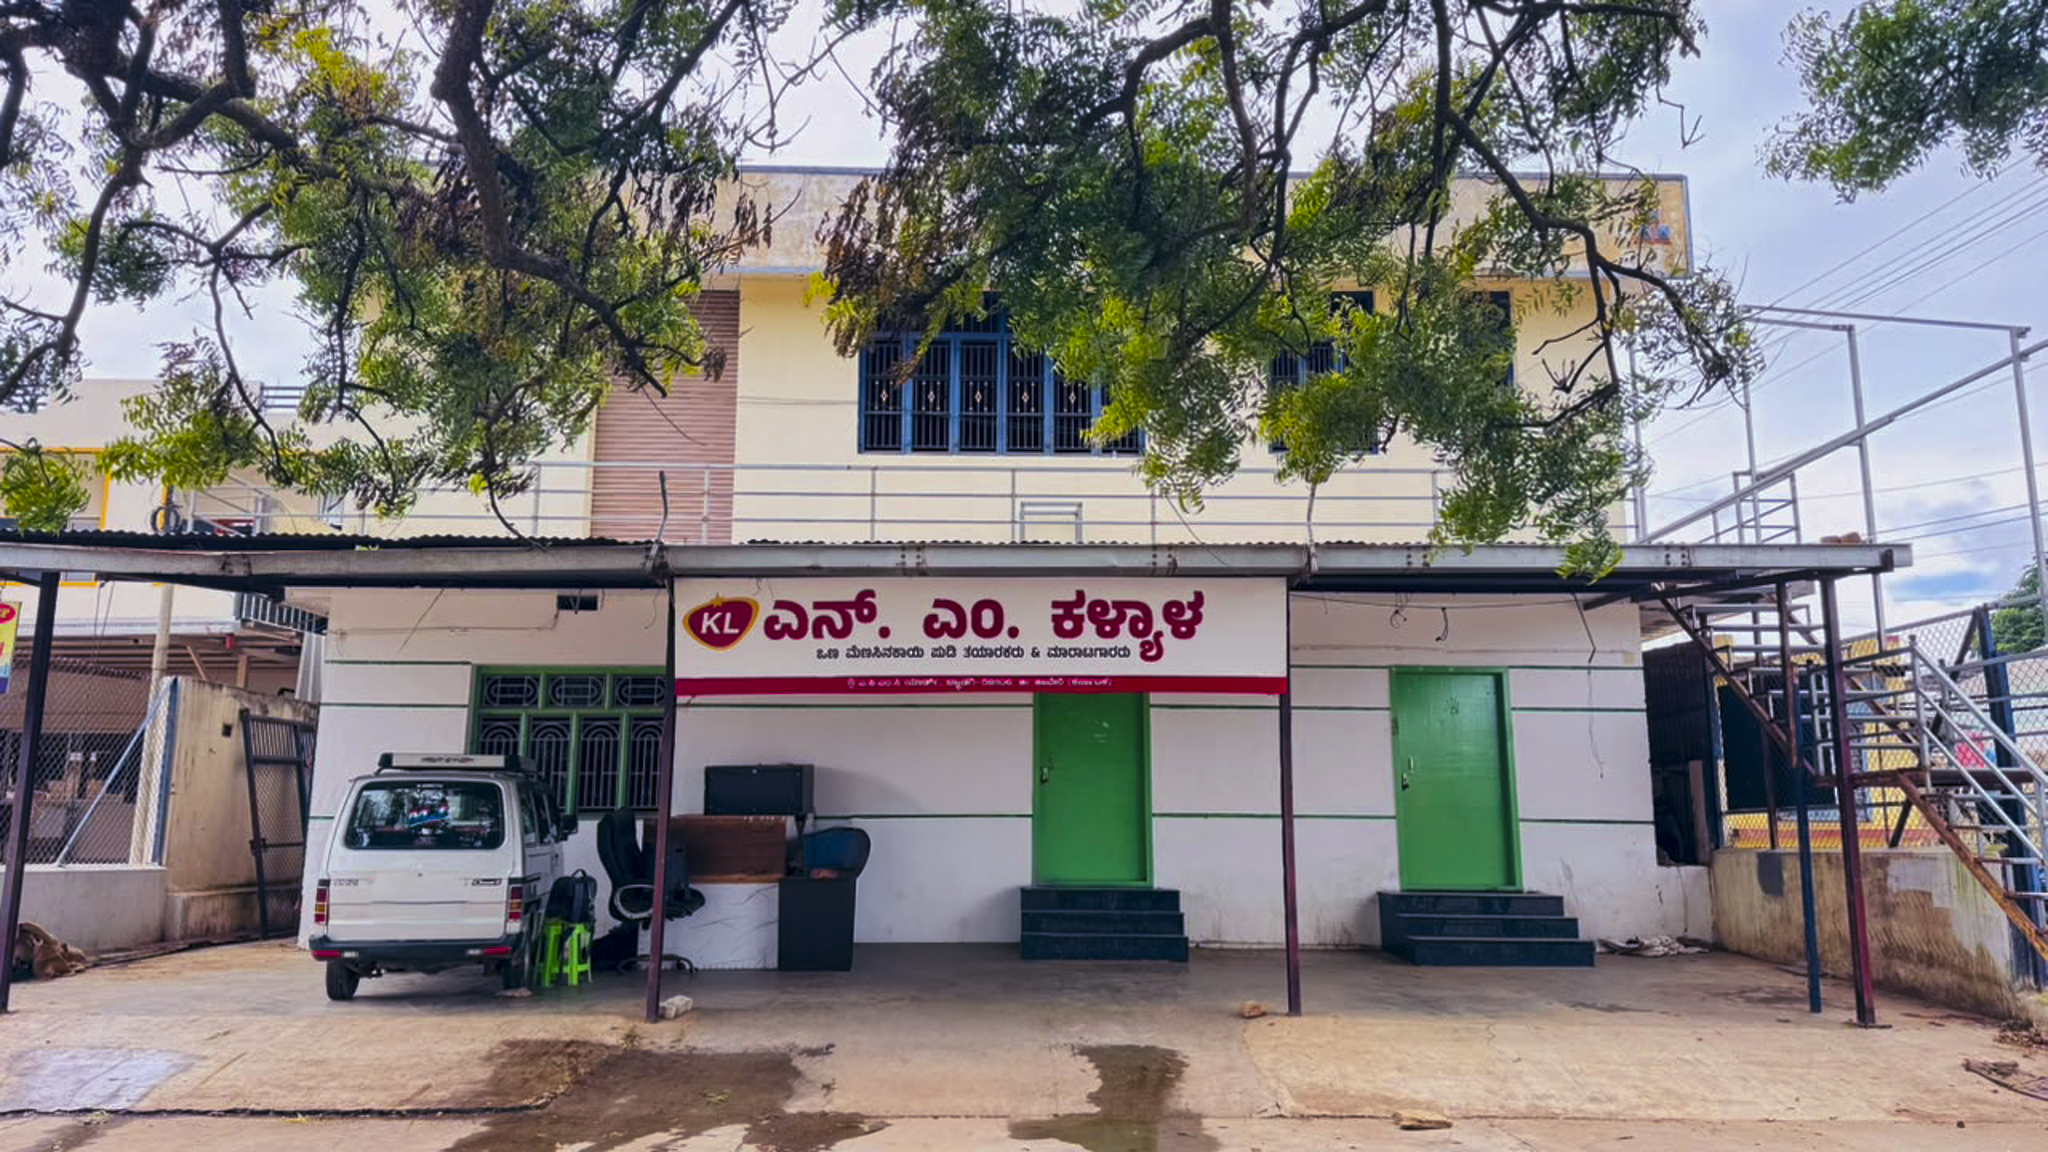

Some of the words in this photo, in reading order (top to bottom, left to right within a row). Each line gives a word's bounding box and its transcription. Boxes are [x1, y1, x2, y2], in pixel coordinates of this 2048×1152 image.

[700, 612, 740, 634] KL
[764, 590, 891, 641] ಎನ್.
[924, 598, 1020, 640] ಎಂ.
[1051, 590, 1204, 662] ಕಳ್ಯಾಳ
[816, 647, 839, 659] ಒಣ
[1030, 646, 1041, 658] &
